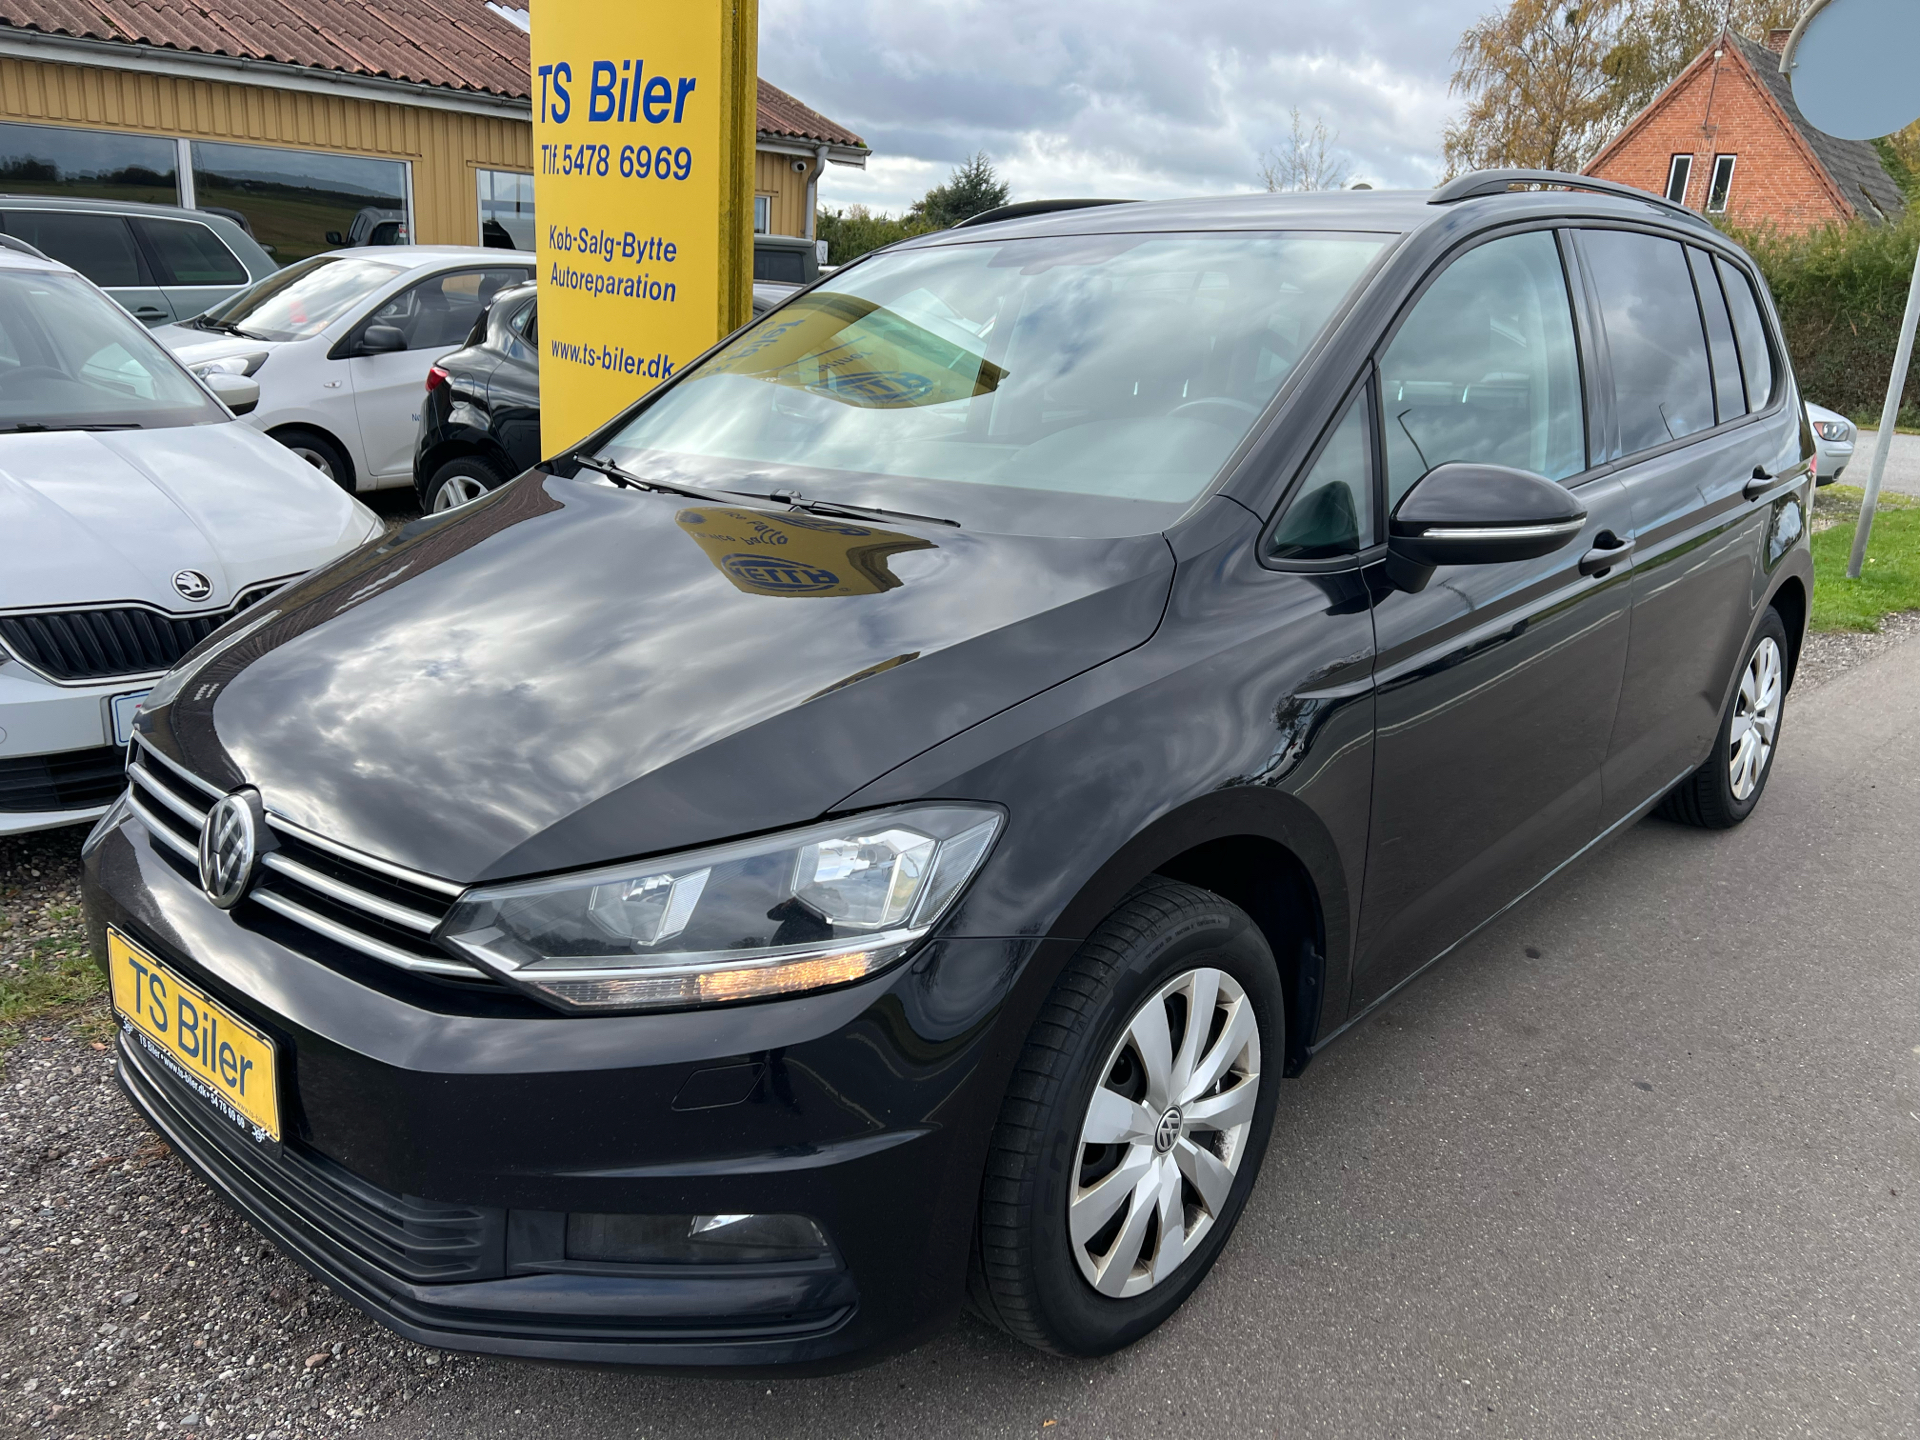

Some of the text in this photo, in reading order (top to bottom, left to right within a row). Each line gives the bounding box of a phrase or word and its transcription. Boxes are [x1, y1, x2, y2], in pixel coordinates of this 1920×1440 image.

[538, 59, 696, 124] TS Biler
[619, 144, 692, 181] 6969
[549, 224, 677, 264] Køb-Salg-Bytte
[550, 261, 676, 302] Autoreparation
[551, 339, 675, 380] www.ts-biler.dk
[129, 956, 253, 1097] TS Biler
